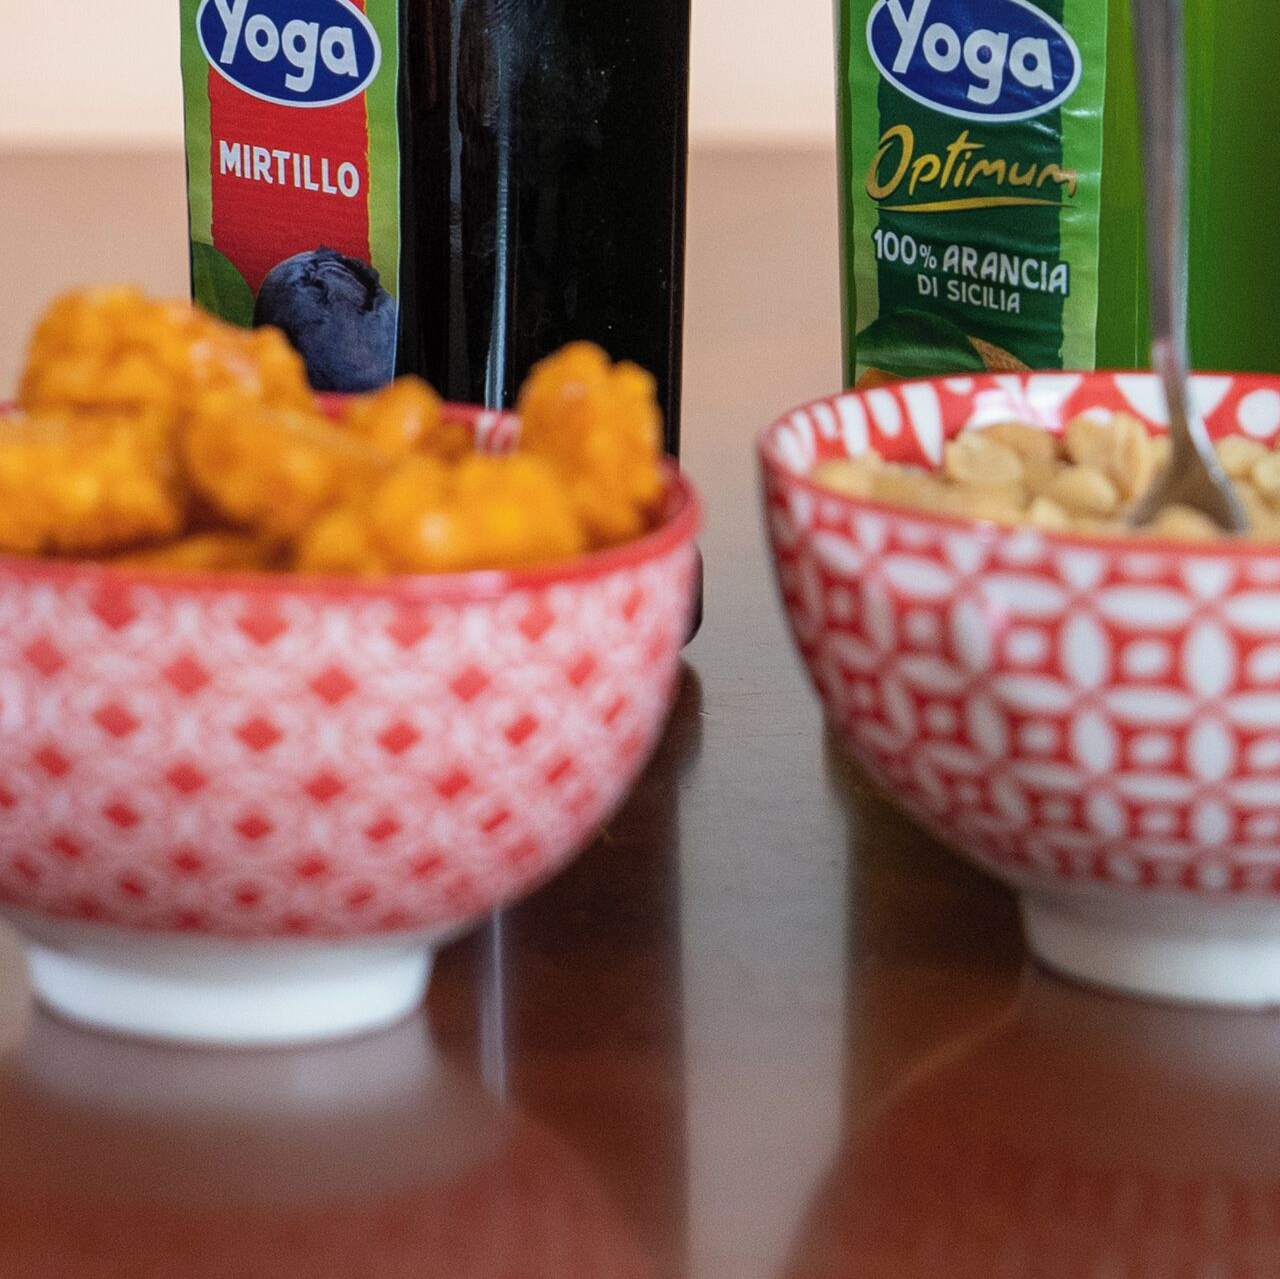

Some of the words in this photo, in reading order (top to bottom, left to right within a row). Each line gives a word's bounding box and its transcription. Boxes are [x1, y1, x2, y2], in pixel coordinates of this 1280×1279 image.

[219, 139, 361, 199] MIRTILLO
[865, 123, 1079, 201] Optimum
[873, 228, 939, 271] 100%
[942, 243, 1070, 297] ARANCIA
[916, 273, 939, 299] DI
[946, 279, 1021, 315] SICILIA
